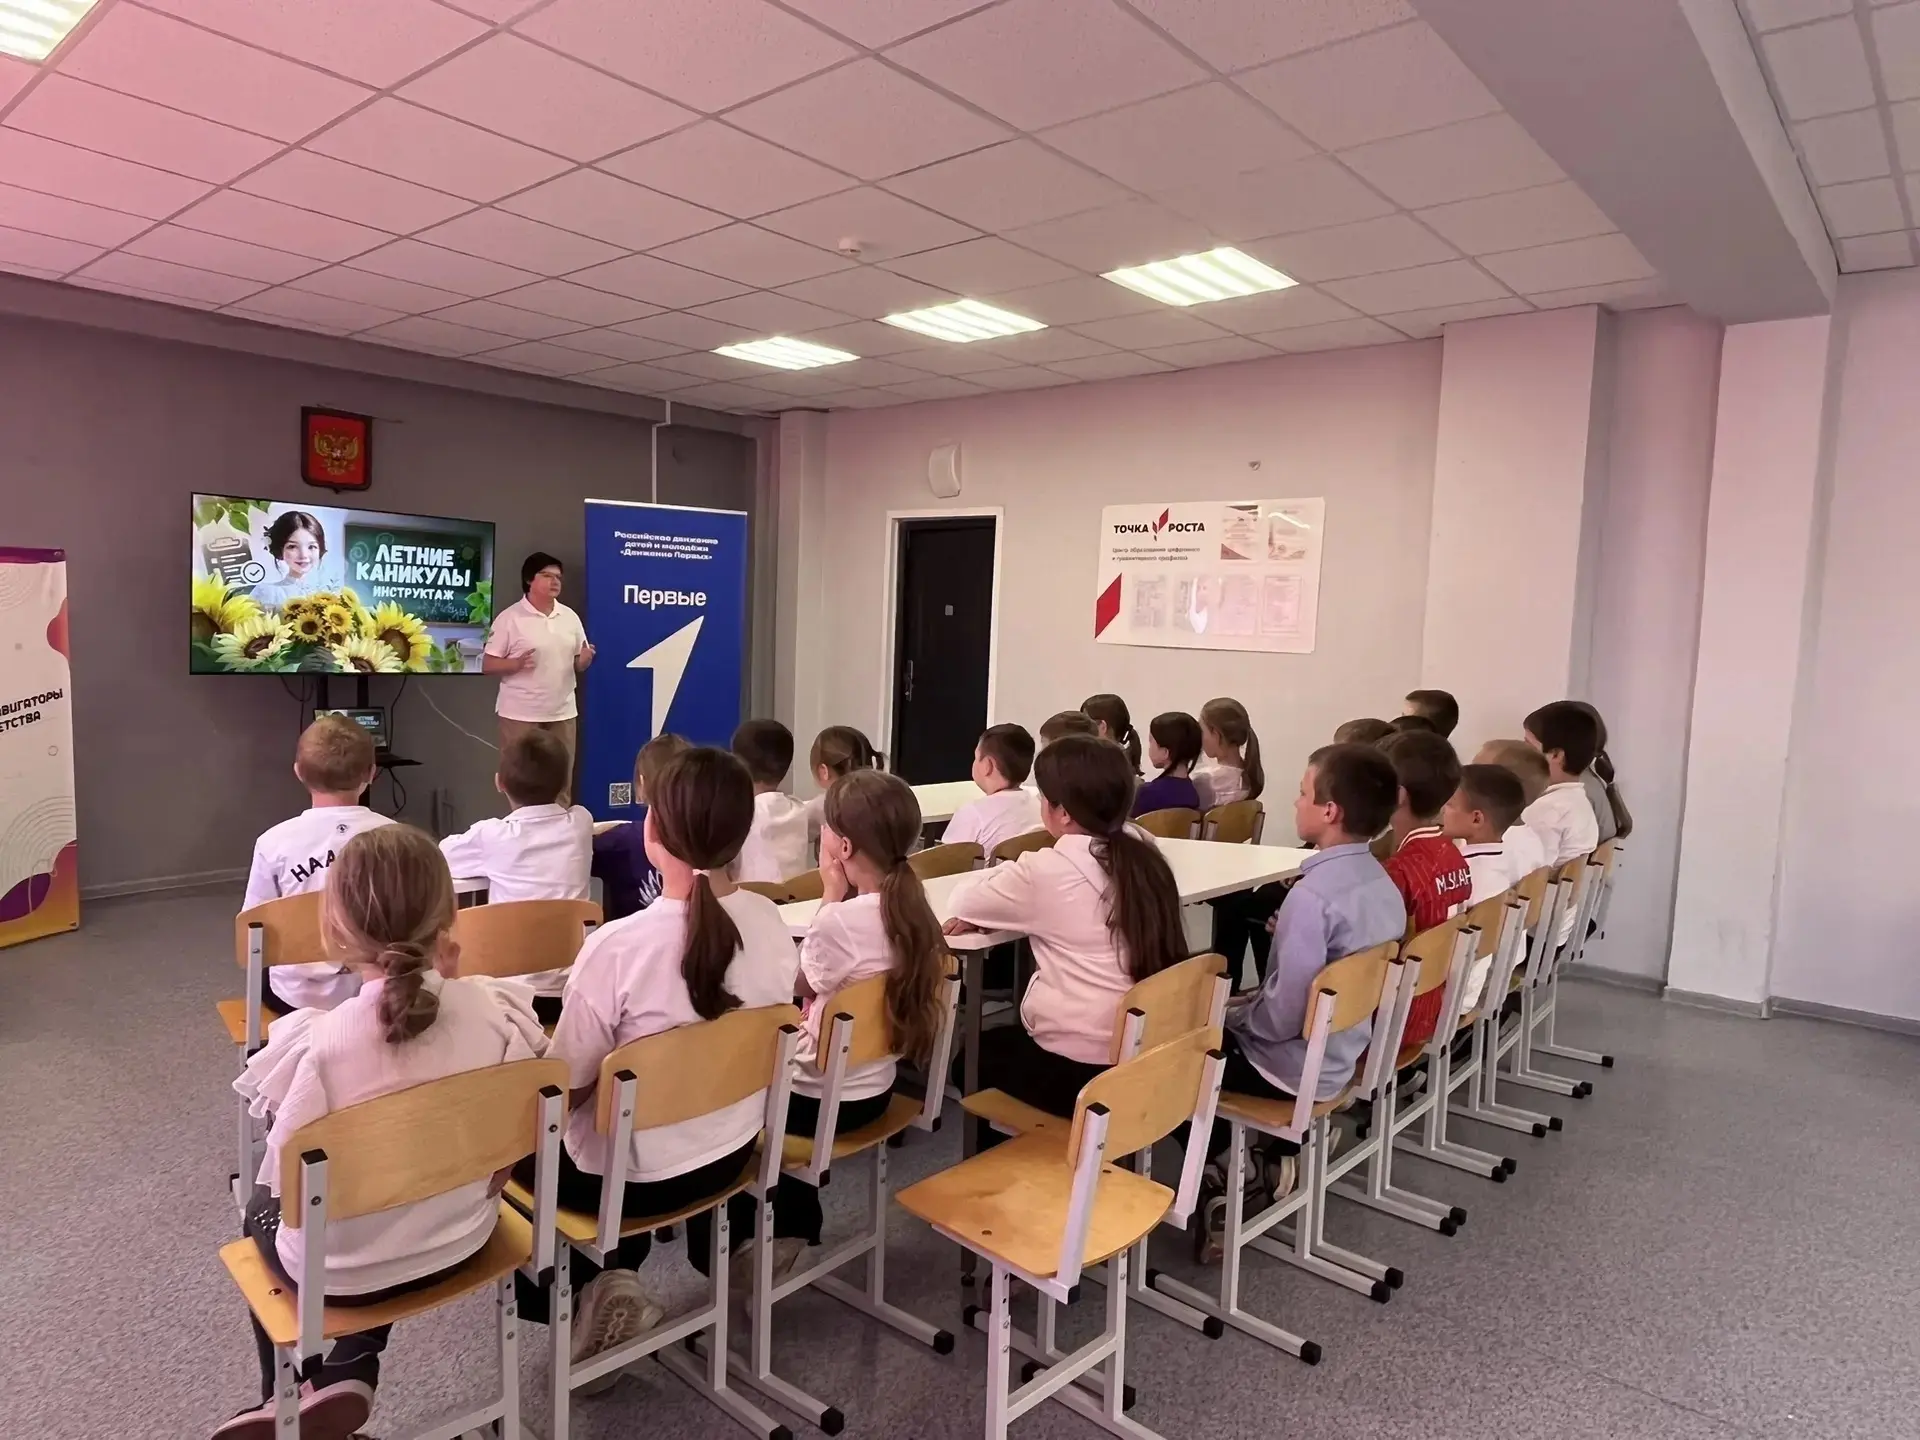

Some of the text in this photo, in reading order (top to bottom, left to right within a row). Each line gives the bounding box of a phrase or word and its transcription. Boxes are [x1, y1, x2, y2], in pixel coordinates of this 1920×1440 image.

[614, 531, 719, 545] Российское движение
[1113, 522, 1205, 534] ТОЧКА РОСТА
[375, 543, 455, 567] ЛЕТНИЕ
[624, 541, 652, 549] детей
[356, 561, 471, 587] КАНИКУЛЫ
[372, 585, 455, 600] ИНСТРУКТАЖ
[623, 584, 707, 611] Первые
[0, 688, 63, 717] ВИГАТОРЫ
[290, 849, 336, 883] HAA
